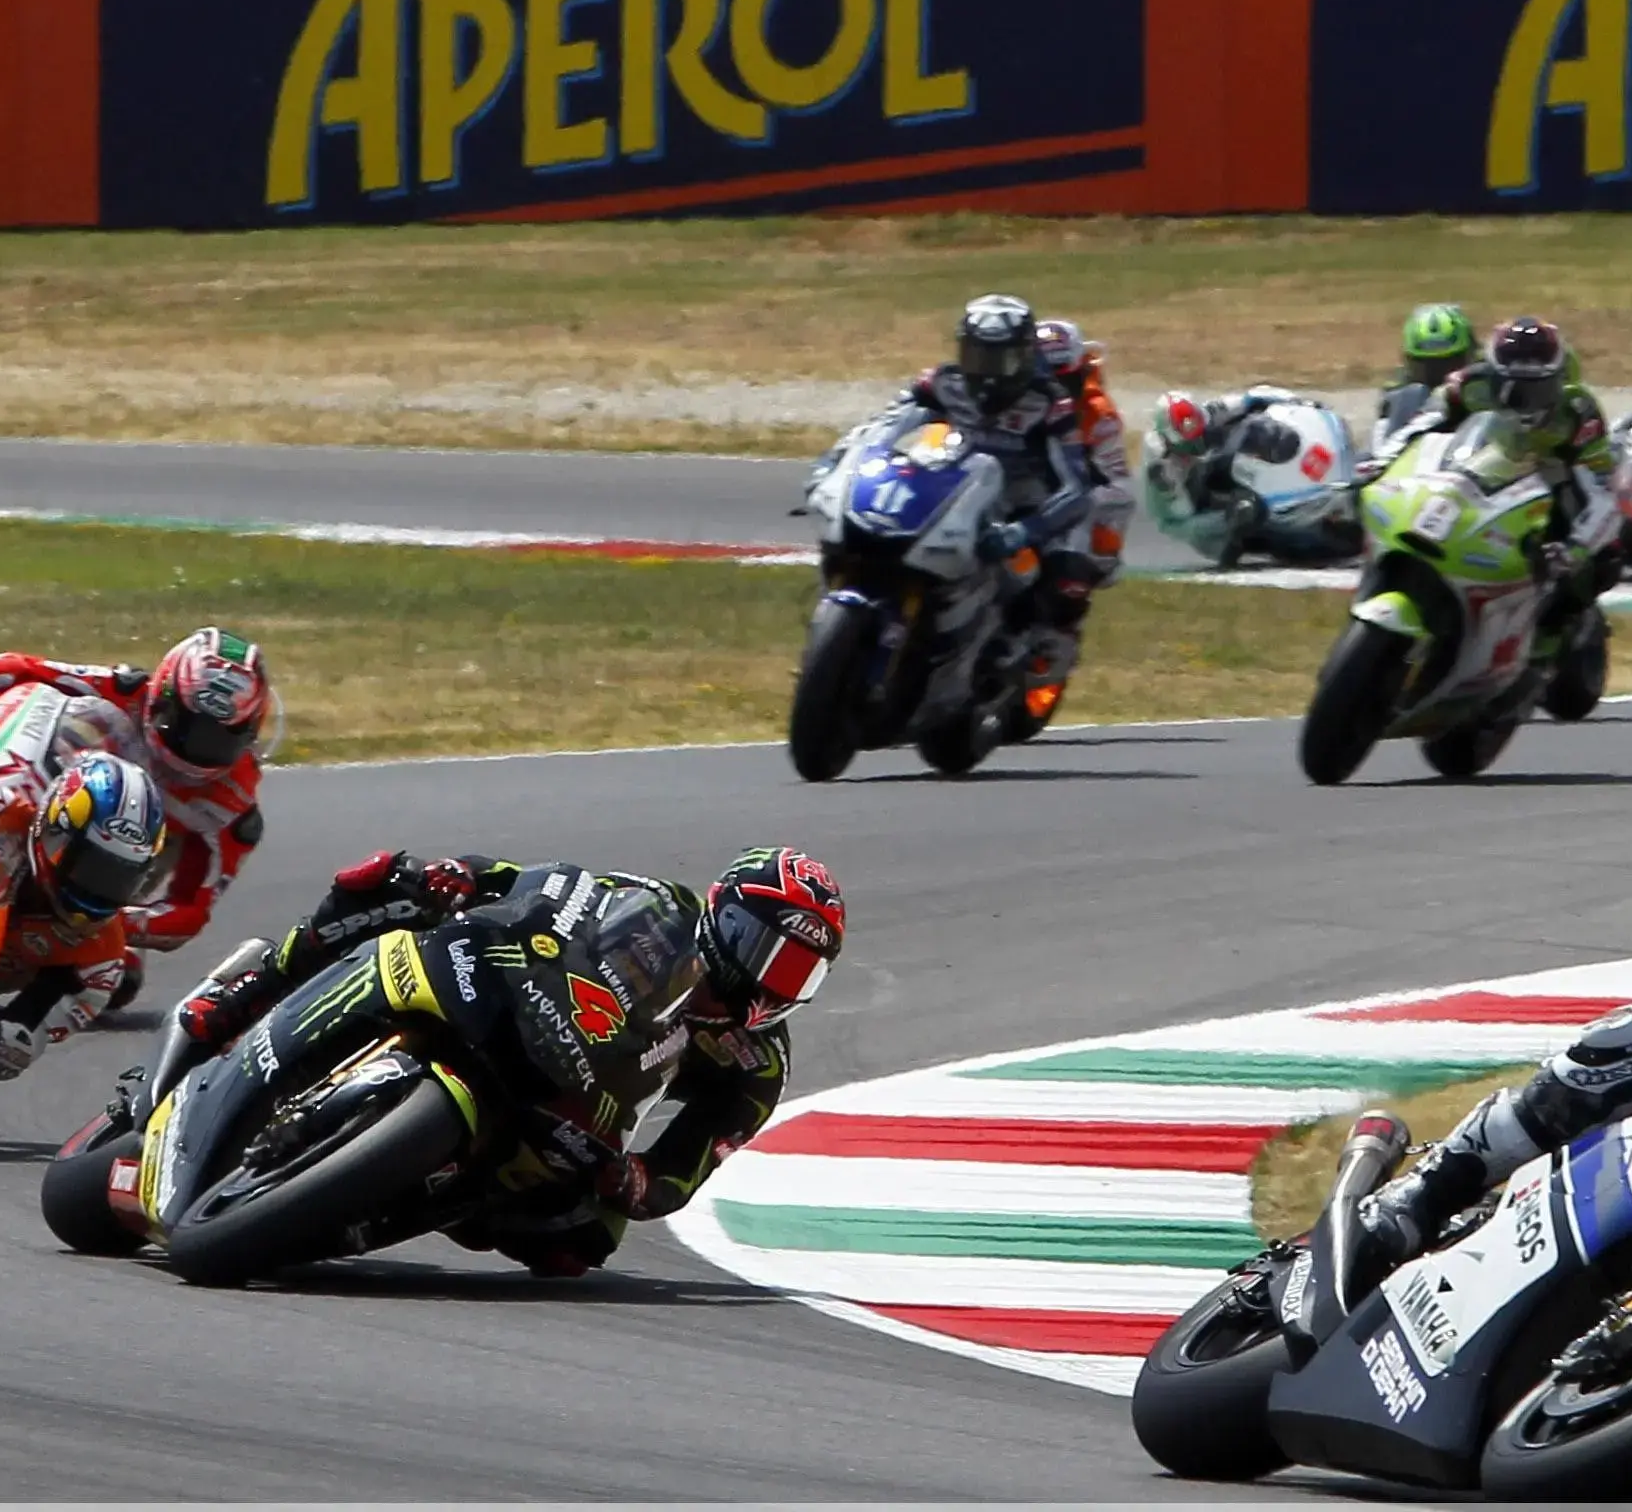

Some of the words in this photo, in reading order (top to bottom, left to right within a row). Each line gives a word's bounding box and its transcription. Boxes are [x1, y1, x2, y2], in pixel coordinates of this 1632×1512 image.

[779, 910, 831, 949] Airoh
[566, 971, 627, 1045] 4
[597, 960, 633, 1014] YAMAHA
[521, 978, 596, 1093] MONSTER
[1398, 1268, 1457, 1358] YAMAHA
